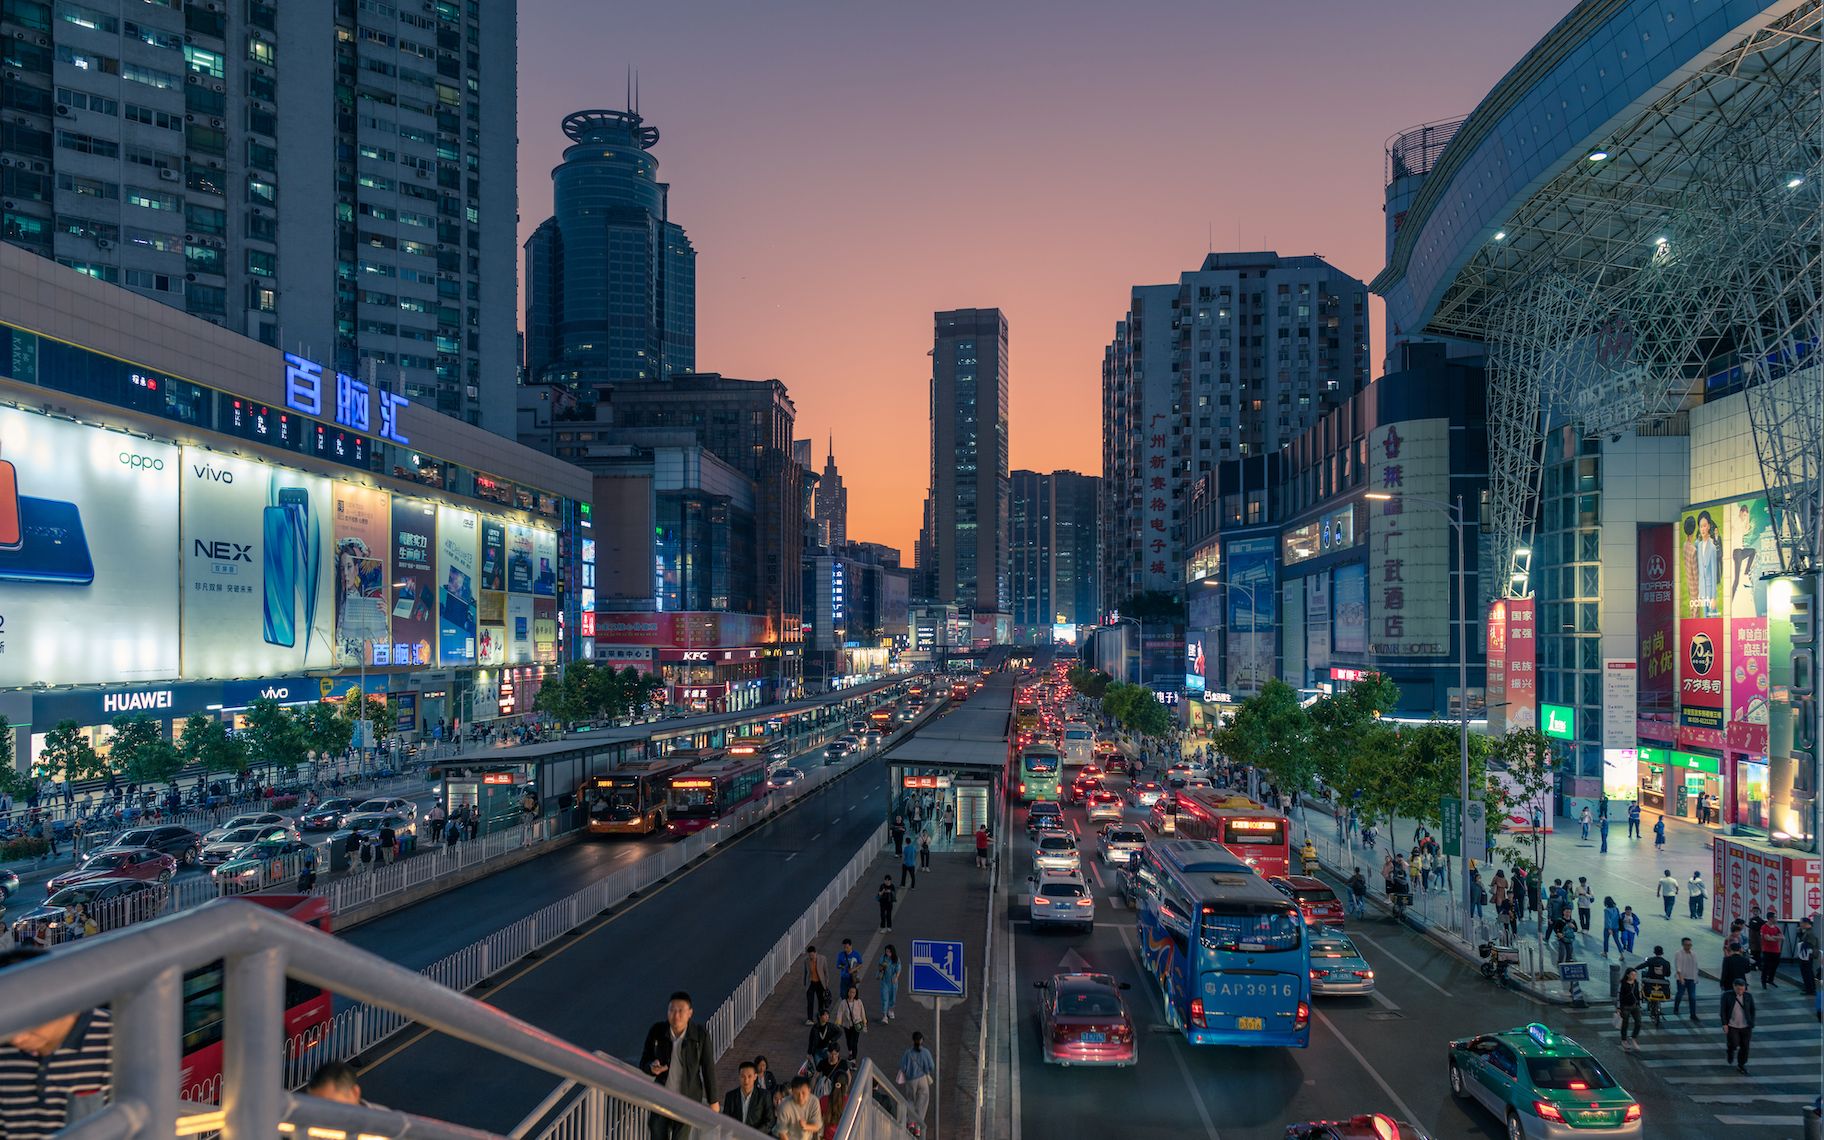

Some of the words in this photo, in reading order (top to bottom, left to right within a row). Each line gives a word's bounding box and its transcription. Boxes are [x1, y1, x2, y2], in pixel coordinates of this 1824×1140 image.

[284, 352, 409, 445] 百脑汇
[194, 464, 233, 484] vivo
[1151, 414, 1166, 574] 广州新赛格电子城
[195, 539, 252, 562] NEX
[1511, 611, 1533, 621] 国家
[1511, 628, 1533, 639] 富强
[683, 652, 708, 660] KFC
[1511, 661, 1533, 672] 民族
[1511, 679, 1532, 689] 振兴
[261, 686, 288, 699] vivo
[684, 689, 708, 698] 肯德基
[104, 691, 172, 712] HUAWEI
